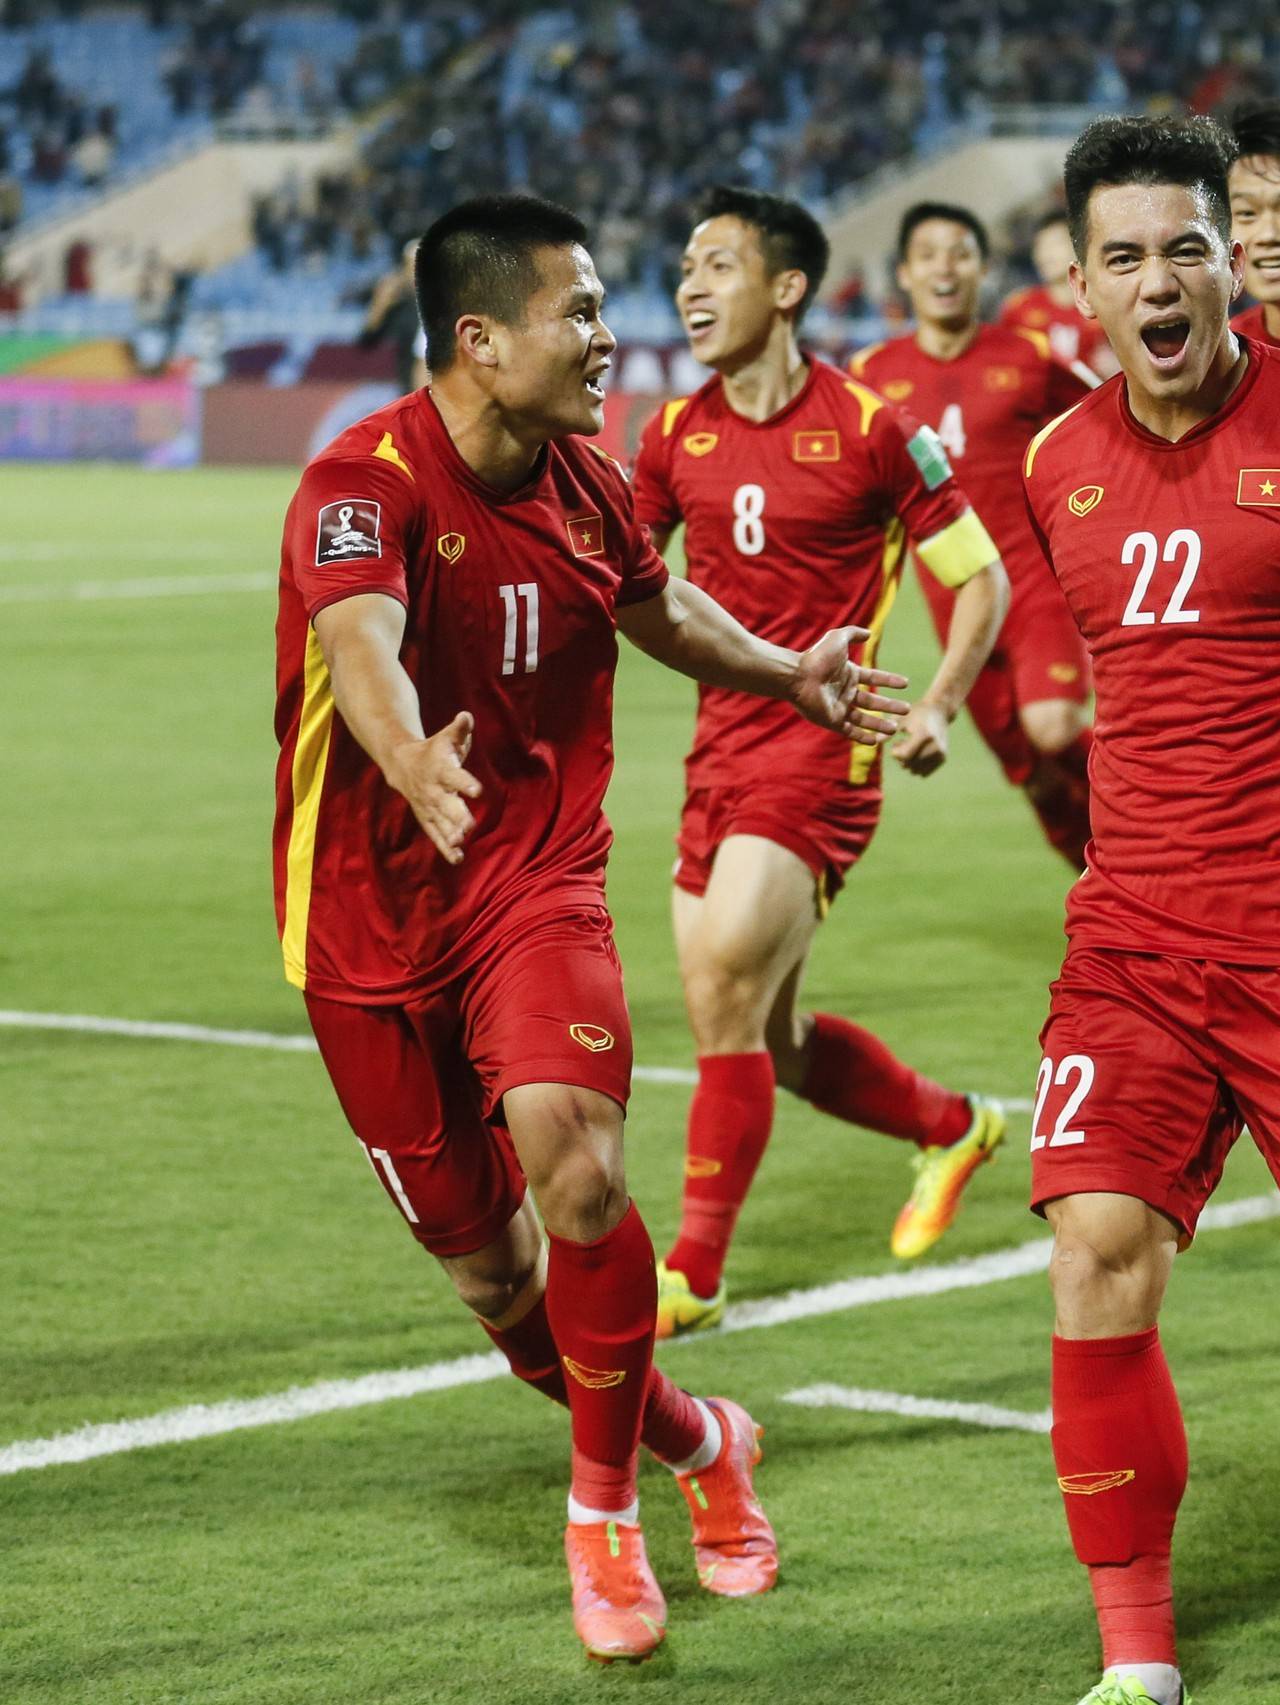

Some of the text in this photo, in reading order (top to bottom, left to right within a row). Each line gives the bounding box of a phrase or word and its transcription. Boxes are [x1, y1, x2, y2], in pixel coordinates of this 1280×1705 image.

[733, 484, 766, 555] 8
[1121, 529, 1201, 626] 22
[499, 583, 539, 675] 11
[1030, 1054, 1095, 1152] 22
